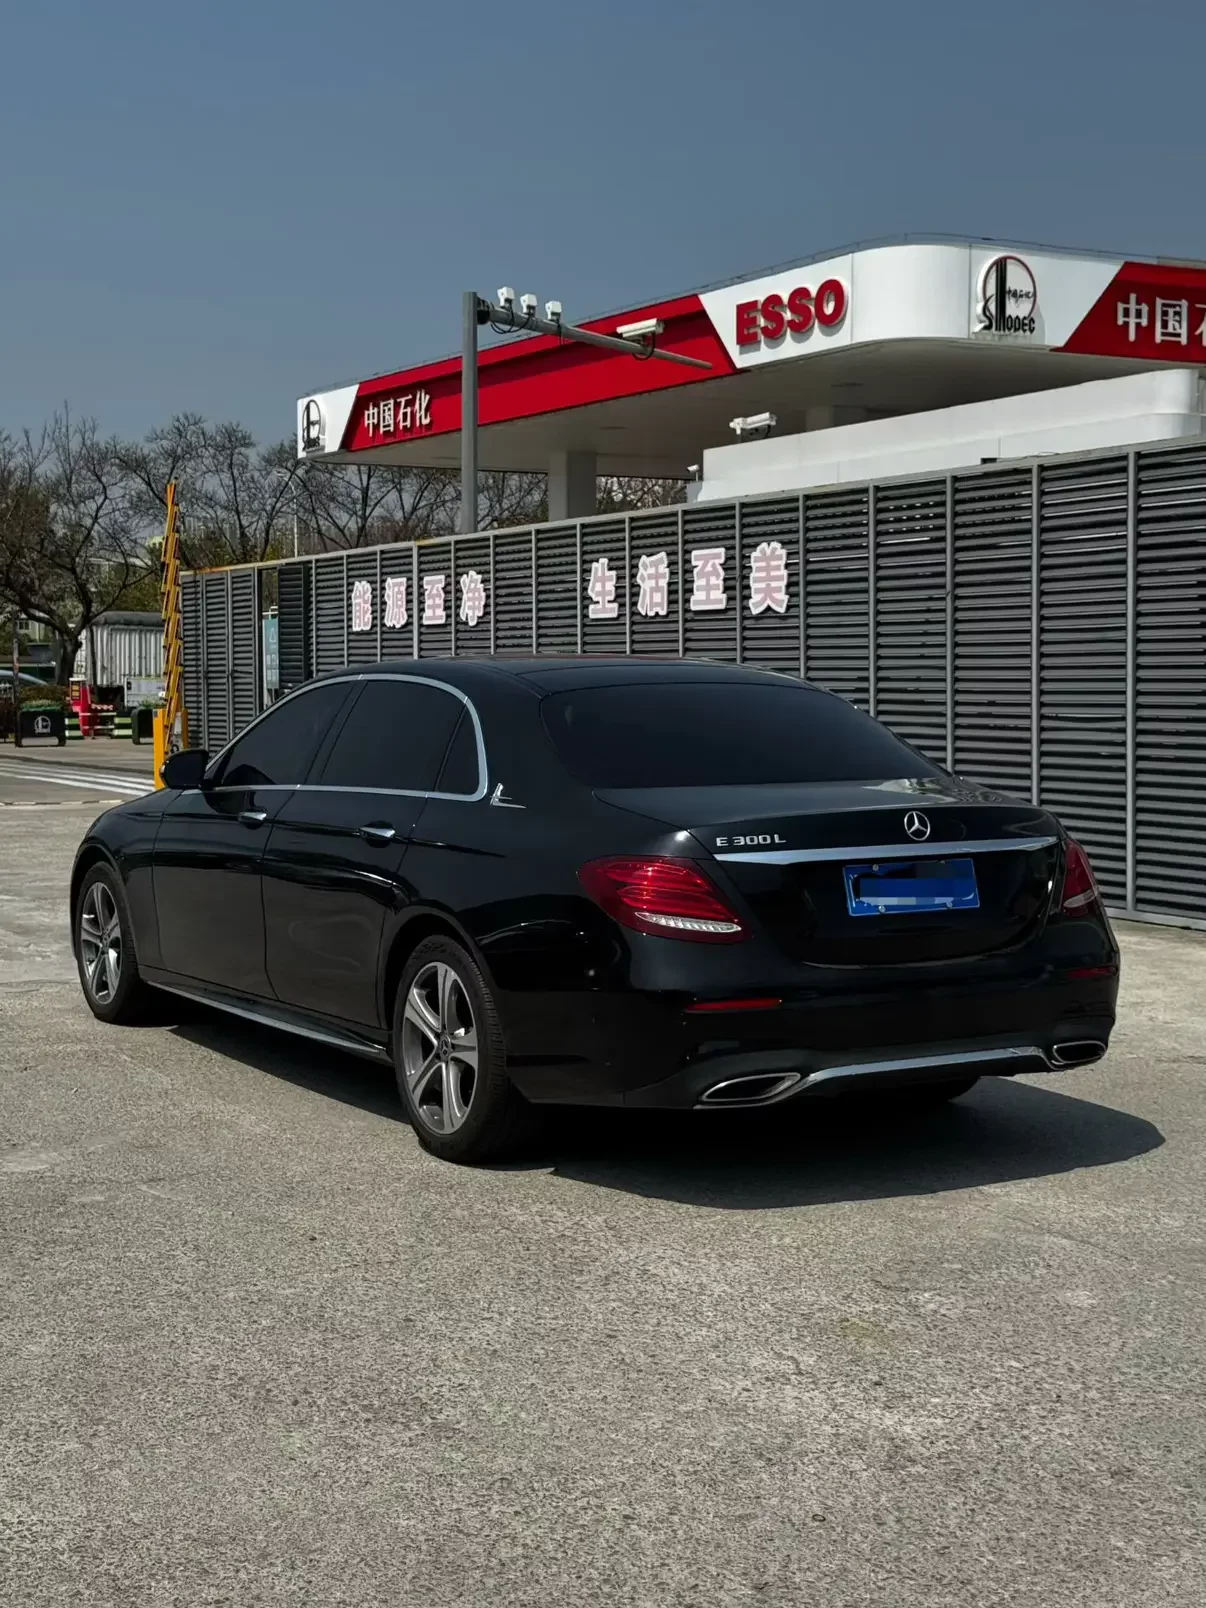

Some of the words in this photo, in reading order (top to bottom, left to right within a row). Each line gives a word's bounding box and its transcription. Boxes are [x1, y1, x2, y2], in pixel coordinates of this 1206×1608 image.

[736, 278, 846, 346] ESSO
[364, 389, 431, 437] 中国石化
[352, 570, 486, 631] 能源至净
[588, 541, 789, 619] 生活至美
[716, 837, 729, 847] E
